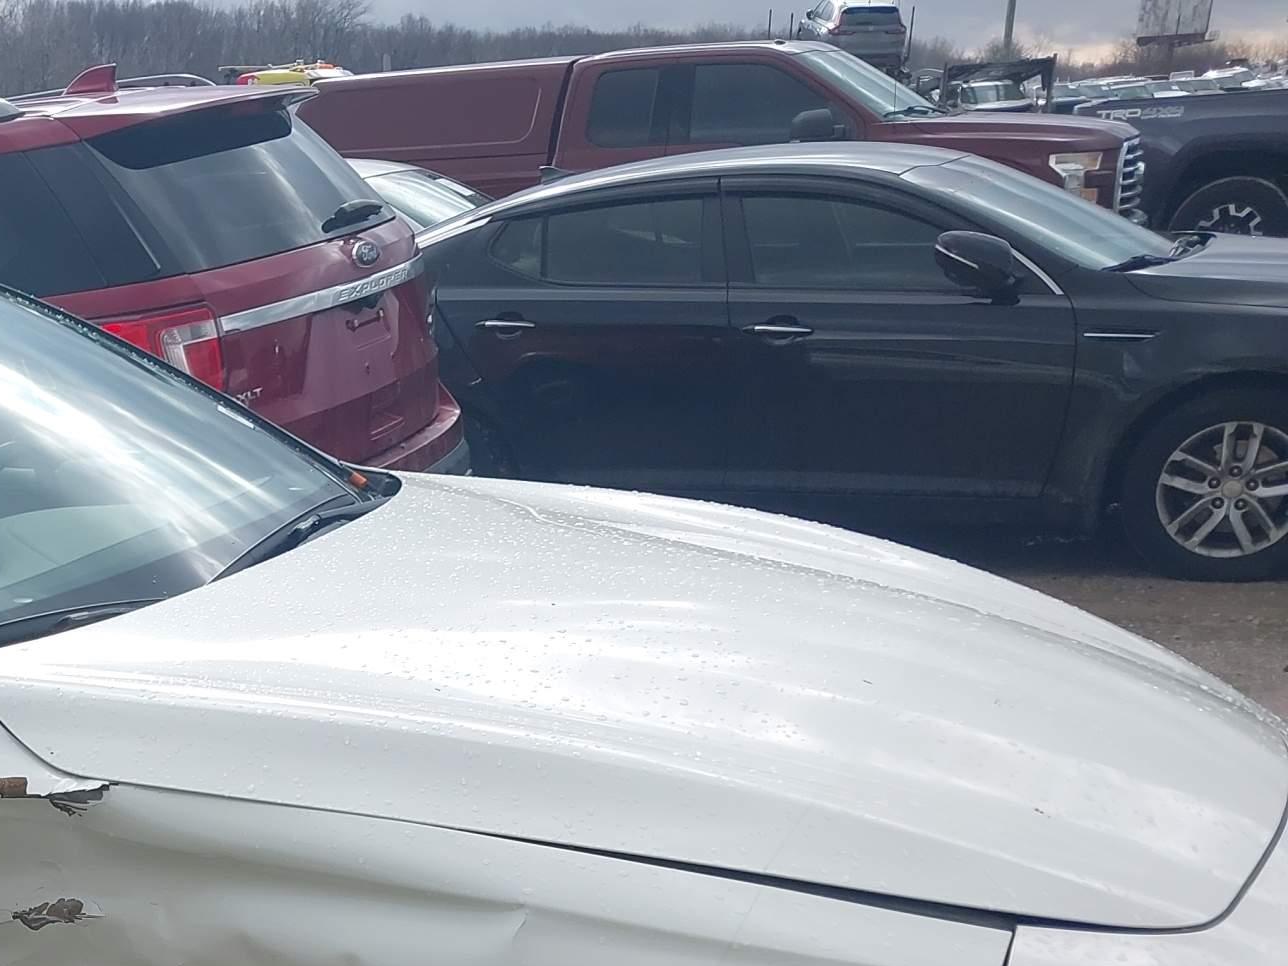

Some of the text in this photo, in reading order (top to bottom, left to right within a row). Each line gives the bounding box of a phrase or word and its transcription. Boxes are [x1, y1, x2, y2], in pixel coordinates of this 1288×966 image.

[1096, 108, 1142, 120] TRD
[338, 268, 409, 301] EXPLORER
[236, 386, 263, 404] XLT
